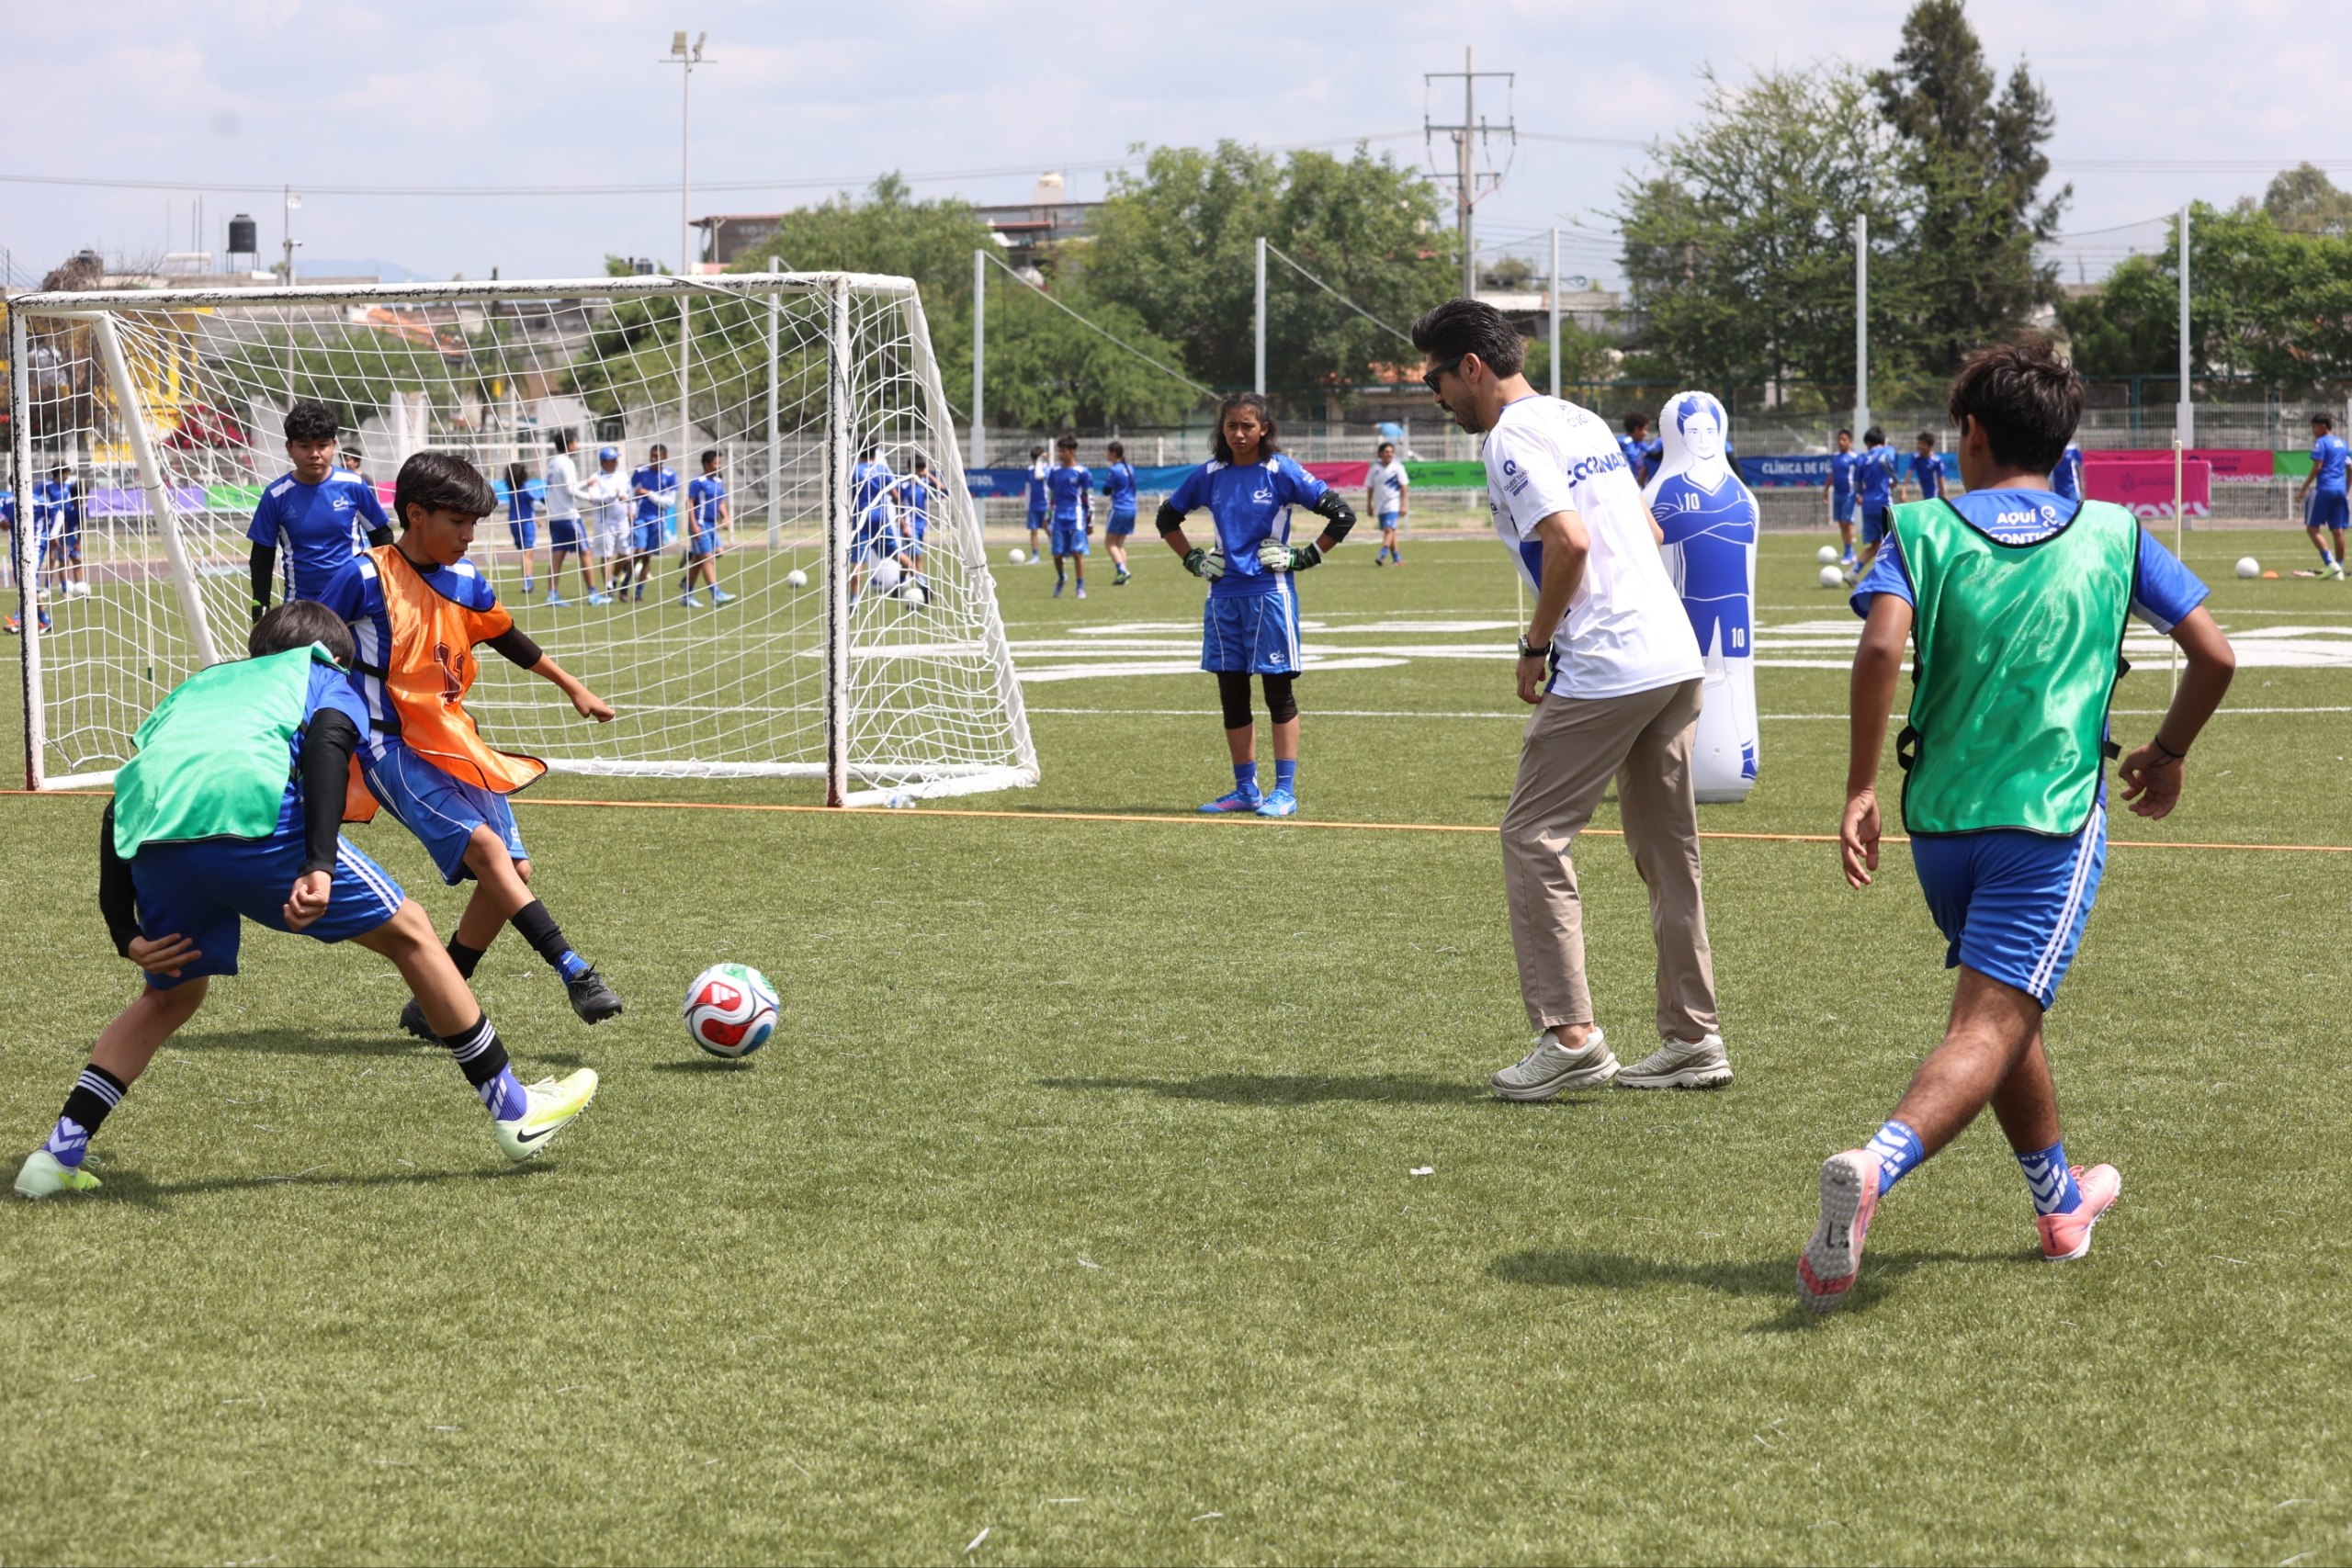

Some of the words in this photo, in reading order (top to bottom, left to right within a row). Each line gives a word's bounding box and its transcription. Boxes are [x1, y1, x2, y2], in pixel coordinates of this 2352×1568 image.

[1761, 461, 1802, 474] CLÍNICA
[1804, 462, 1819, 474] DE
[1683, 492, 1701, 511] 10
[1996, 508, 2037, 525] AQUÍ
[1731, 626, 1746, 649] 10
[2020, 1151, 2047, 1162] NIKE
